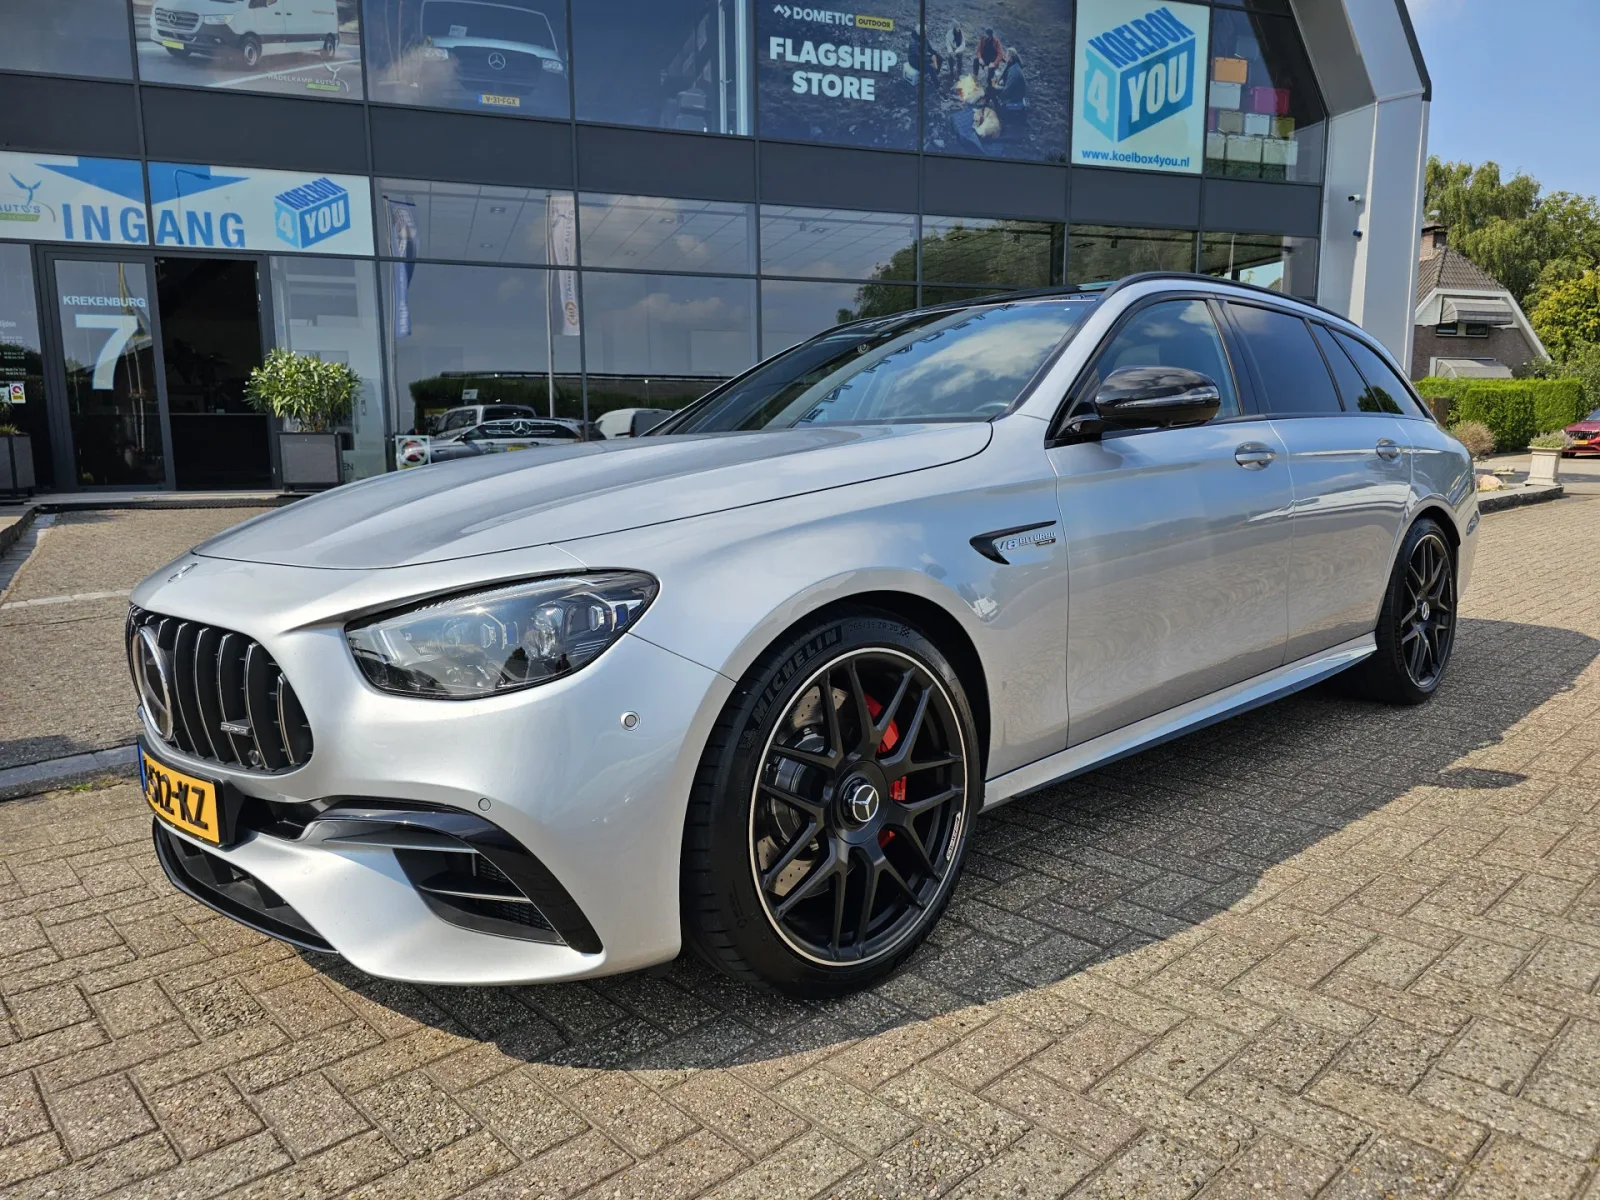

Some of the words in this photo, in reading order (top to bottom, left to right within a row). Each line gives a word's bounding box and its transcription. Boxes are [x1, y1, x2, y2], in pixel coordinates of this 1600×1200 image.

[793, 6, 854, 27] DOMETIC
[858, 18, 891, 29] OUTDOOR
[769, 36, 898, 73] FLAGSHIP
[1087, 6, 1195, 69] KOELBOX
[792, 70, 875, 101] STORE
[1087, 68, 1110, 124] 4
[1127, 51, 1188, 124] YOU
[1082, 149, 1190, 168] www.koelbox4you.nl
[275, 177, 347, 211] KOELBOX
[61, 203, 246, 249] INGANG
[278, 212, 295, 240] 4
[303, 200, 346, 239] YOU
[62, 295, 146, 308] KREKENBURG
[74, 313, 139, 390] 7
[751, 626, 838, 725] MICHELIN
